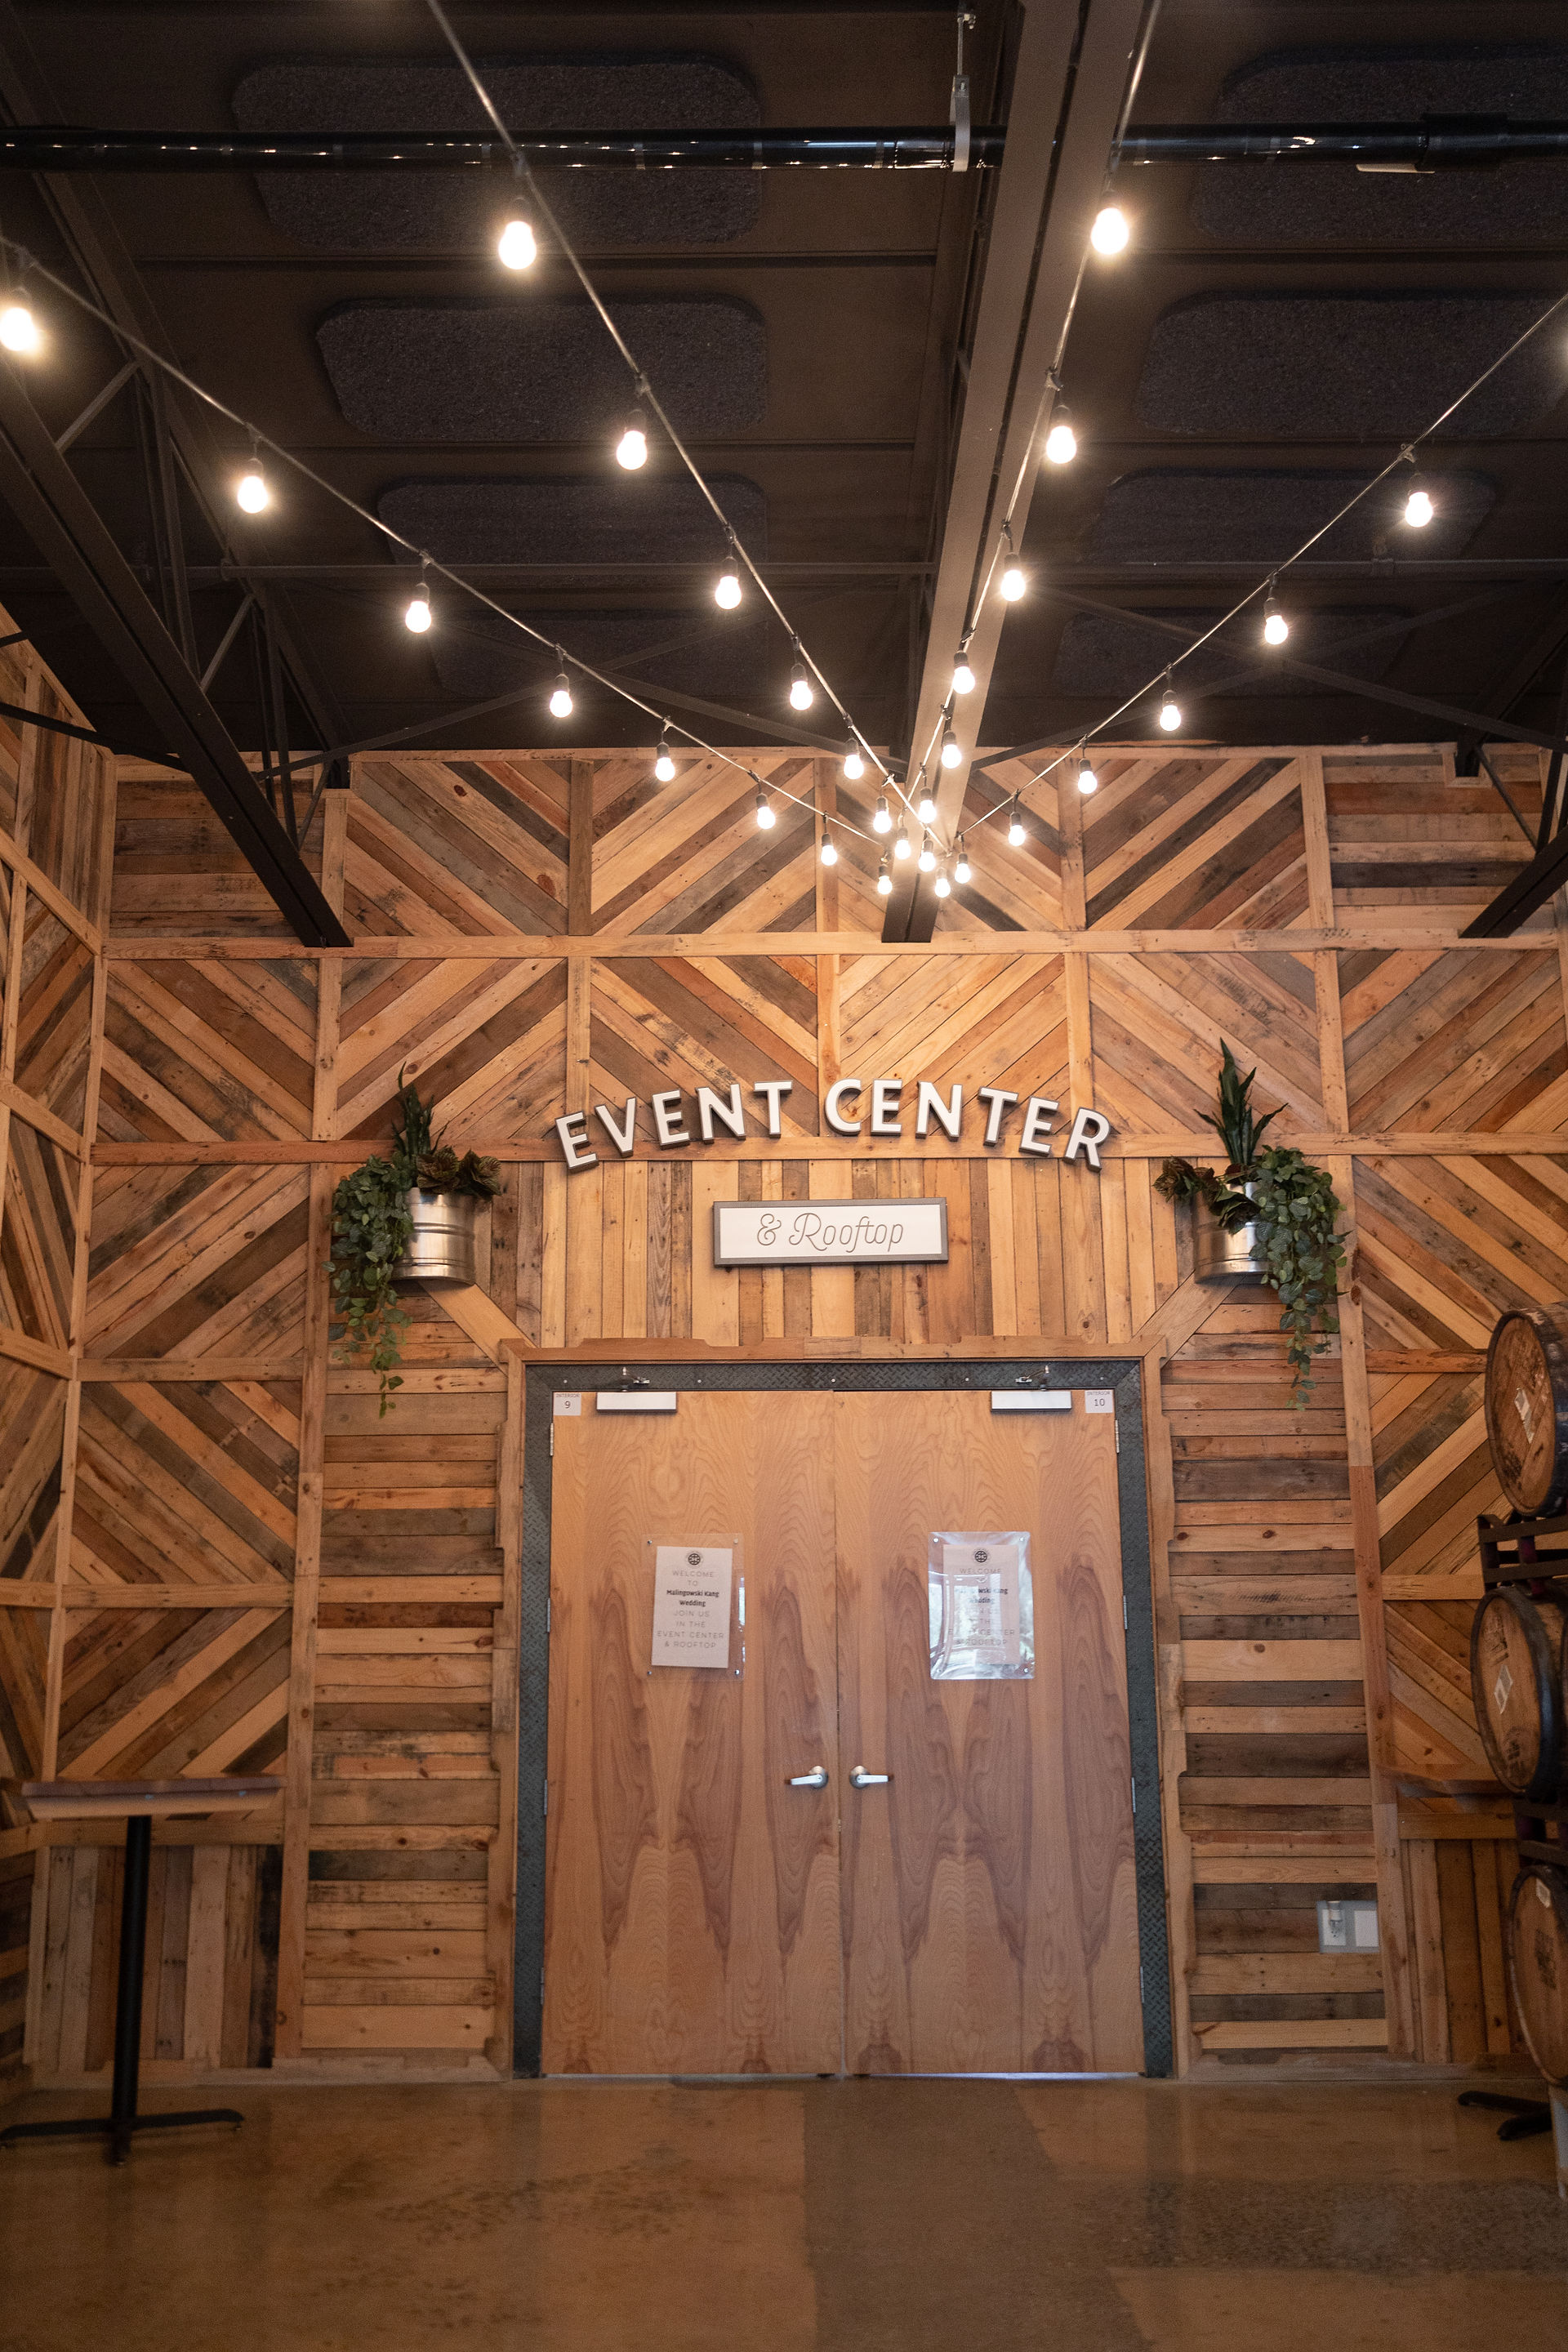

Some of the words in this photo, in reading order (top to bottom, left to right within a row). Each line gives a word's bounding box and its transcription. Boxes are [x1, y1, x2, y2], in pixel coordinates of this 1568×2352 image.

[555, 1080, 793, 1173] EVENT
[825, 1078, 1111, 1172] CENTER
[756, 1213, 782, 1246] &
[788, 1212, 904, 1254] Rooftop
[564, 1401, 571, 1409] 9
[1094, 1398, 1106, 1406] 10
[672, 1570, 714, 1578] WELCOME
[657, 1630, 685, 1638] EVENT
[673, 1641, 716, 1649] ROOFTOP
